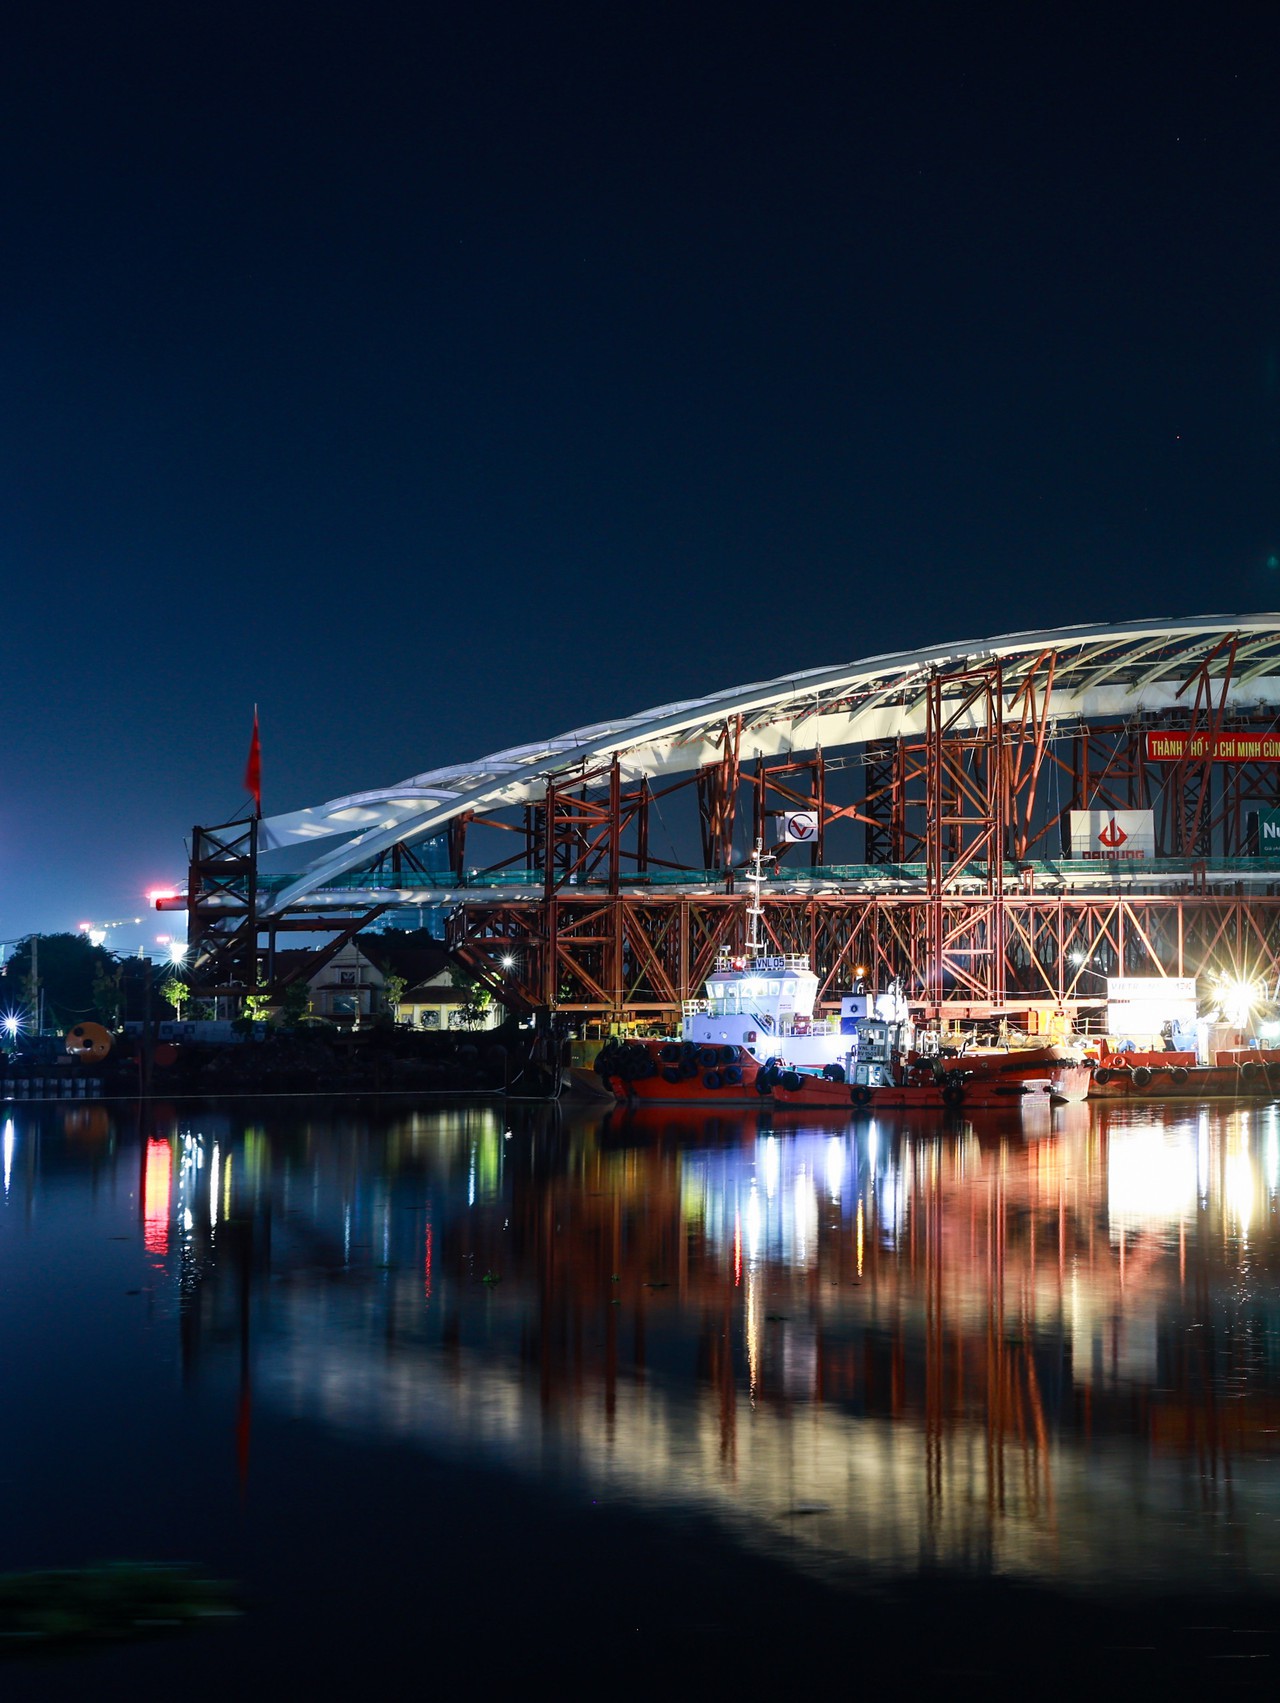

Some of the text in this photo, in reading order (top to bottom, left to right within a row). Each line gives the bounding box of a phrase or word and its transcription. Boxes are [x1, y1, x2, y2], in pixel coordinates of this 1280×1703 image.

[1152, 737, 1182, 756] THÀNH
[1185, 737, 1204, 756] HỐ
[1220, 739, 1235, 757] CHÍ
[1237, 741, 1261, 757] MINH
[756, 958, 785, 968] VNL 05
